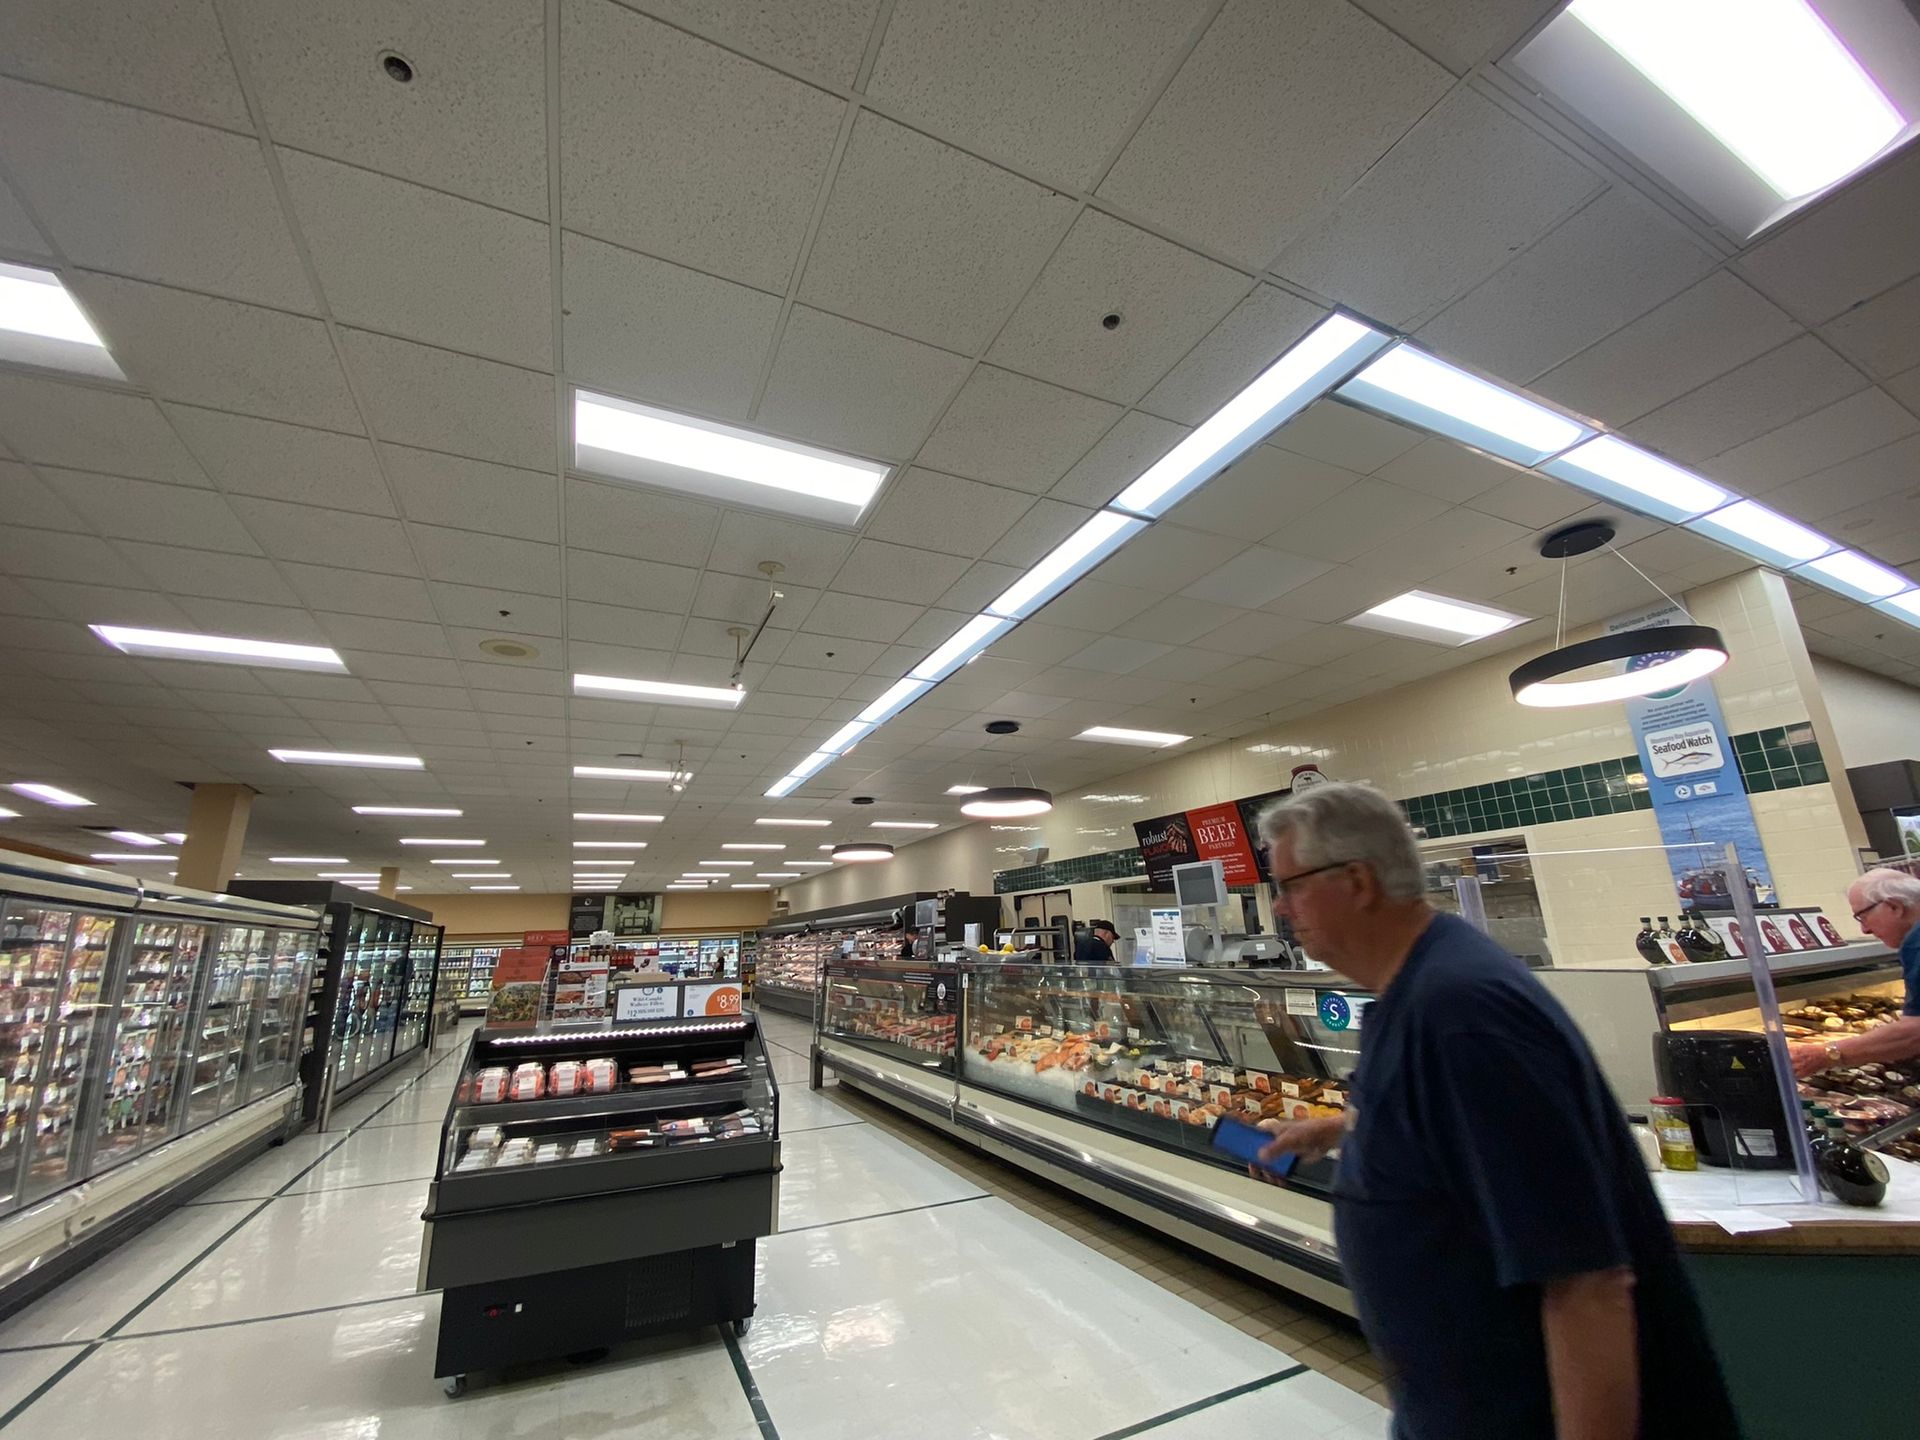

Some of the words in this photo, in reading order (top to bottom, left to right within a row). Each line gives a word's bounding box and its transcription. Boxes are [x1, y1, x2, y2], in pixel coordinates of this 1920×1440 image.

[1652, 740, 1687, 755] Seafood
[1687, 734, 1713, 748] Watch
[1142, 830, 1168, 847] robust
[1197, 822, 1237, 845] BEEF
[716, 994, 740, 1008] $8.99
[1330, 1004, 1339, 1020] S
